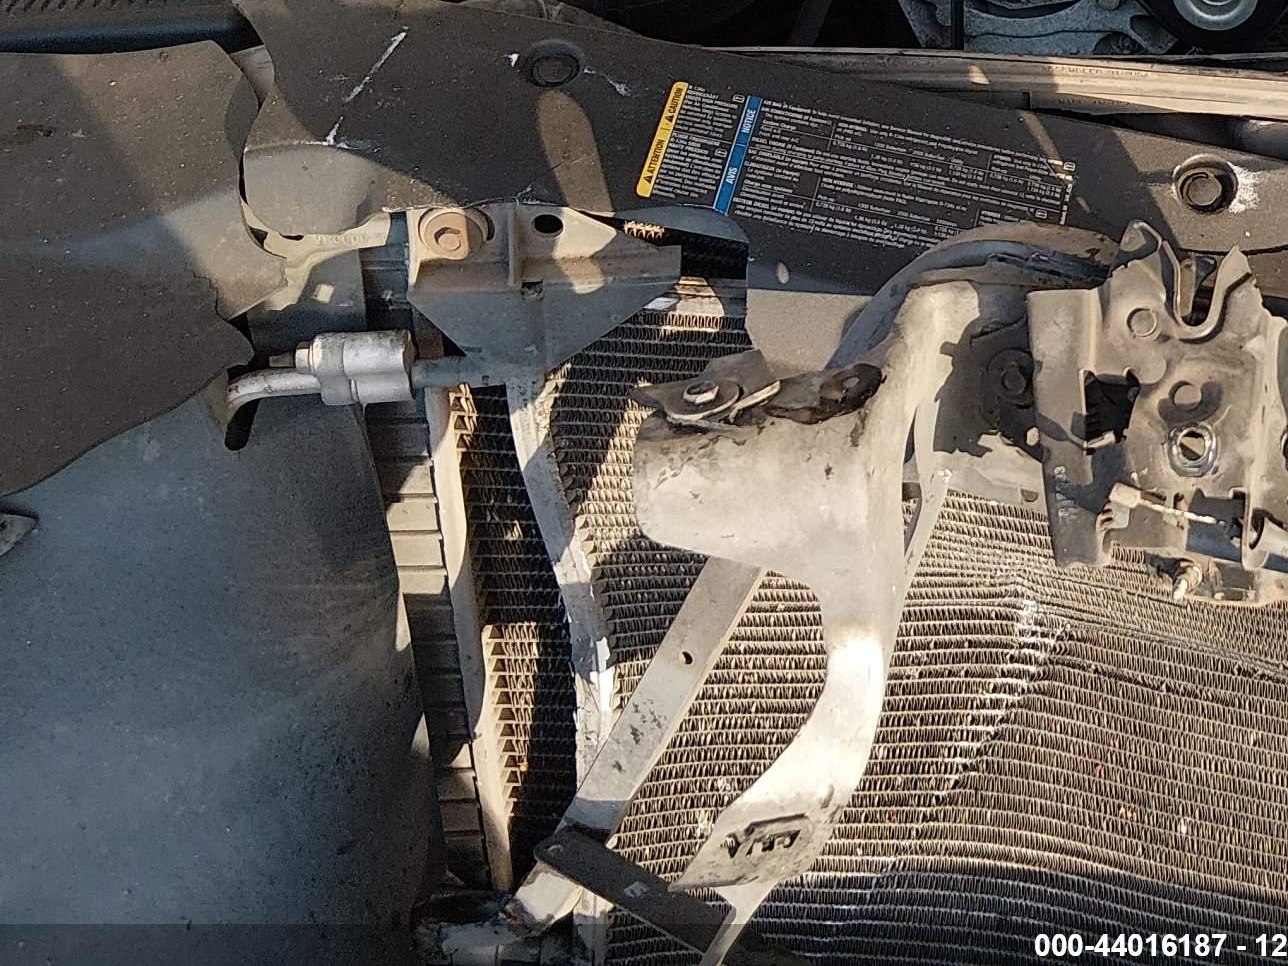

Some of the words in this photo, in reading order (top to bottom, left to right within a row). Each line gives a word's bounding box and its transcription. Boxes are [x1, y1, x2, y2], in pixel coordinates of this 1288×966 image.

[668, 87, 684, 114] CAUTION
[740, 109, 757, 134] NOTICE
[647, 139, 665, 175] ATTENTION
[725, 167, 738, 184] AVIS
